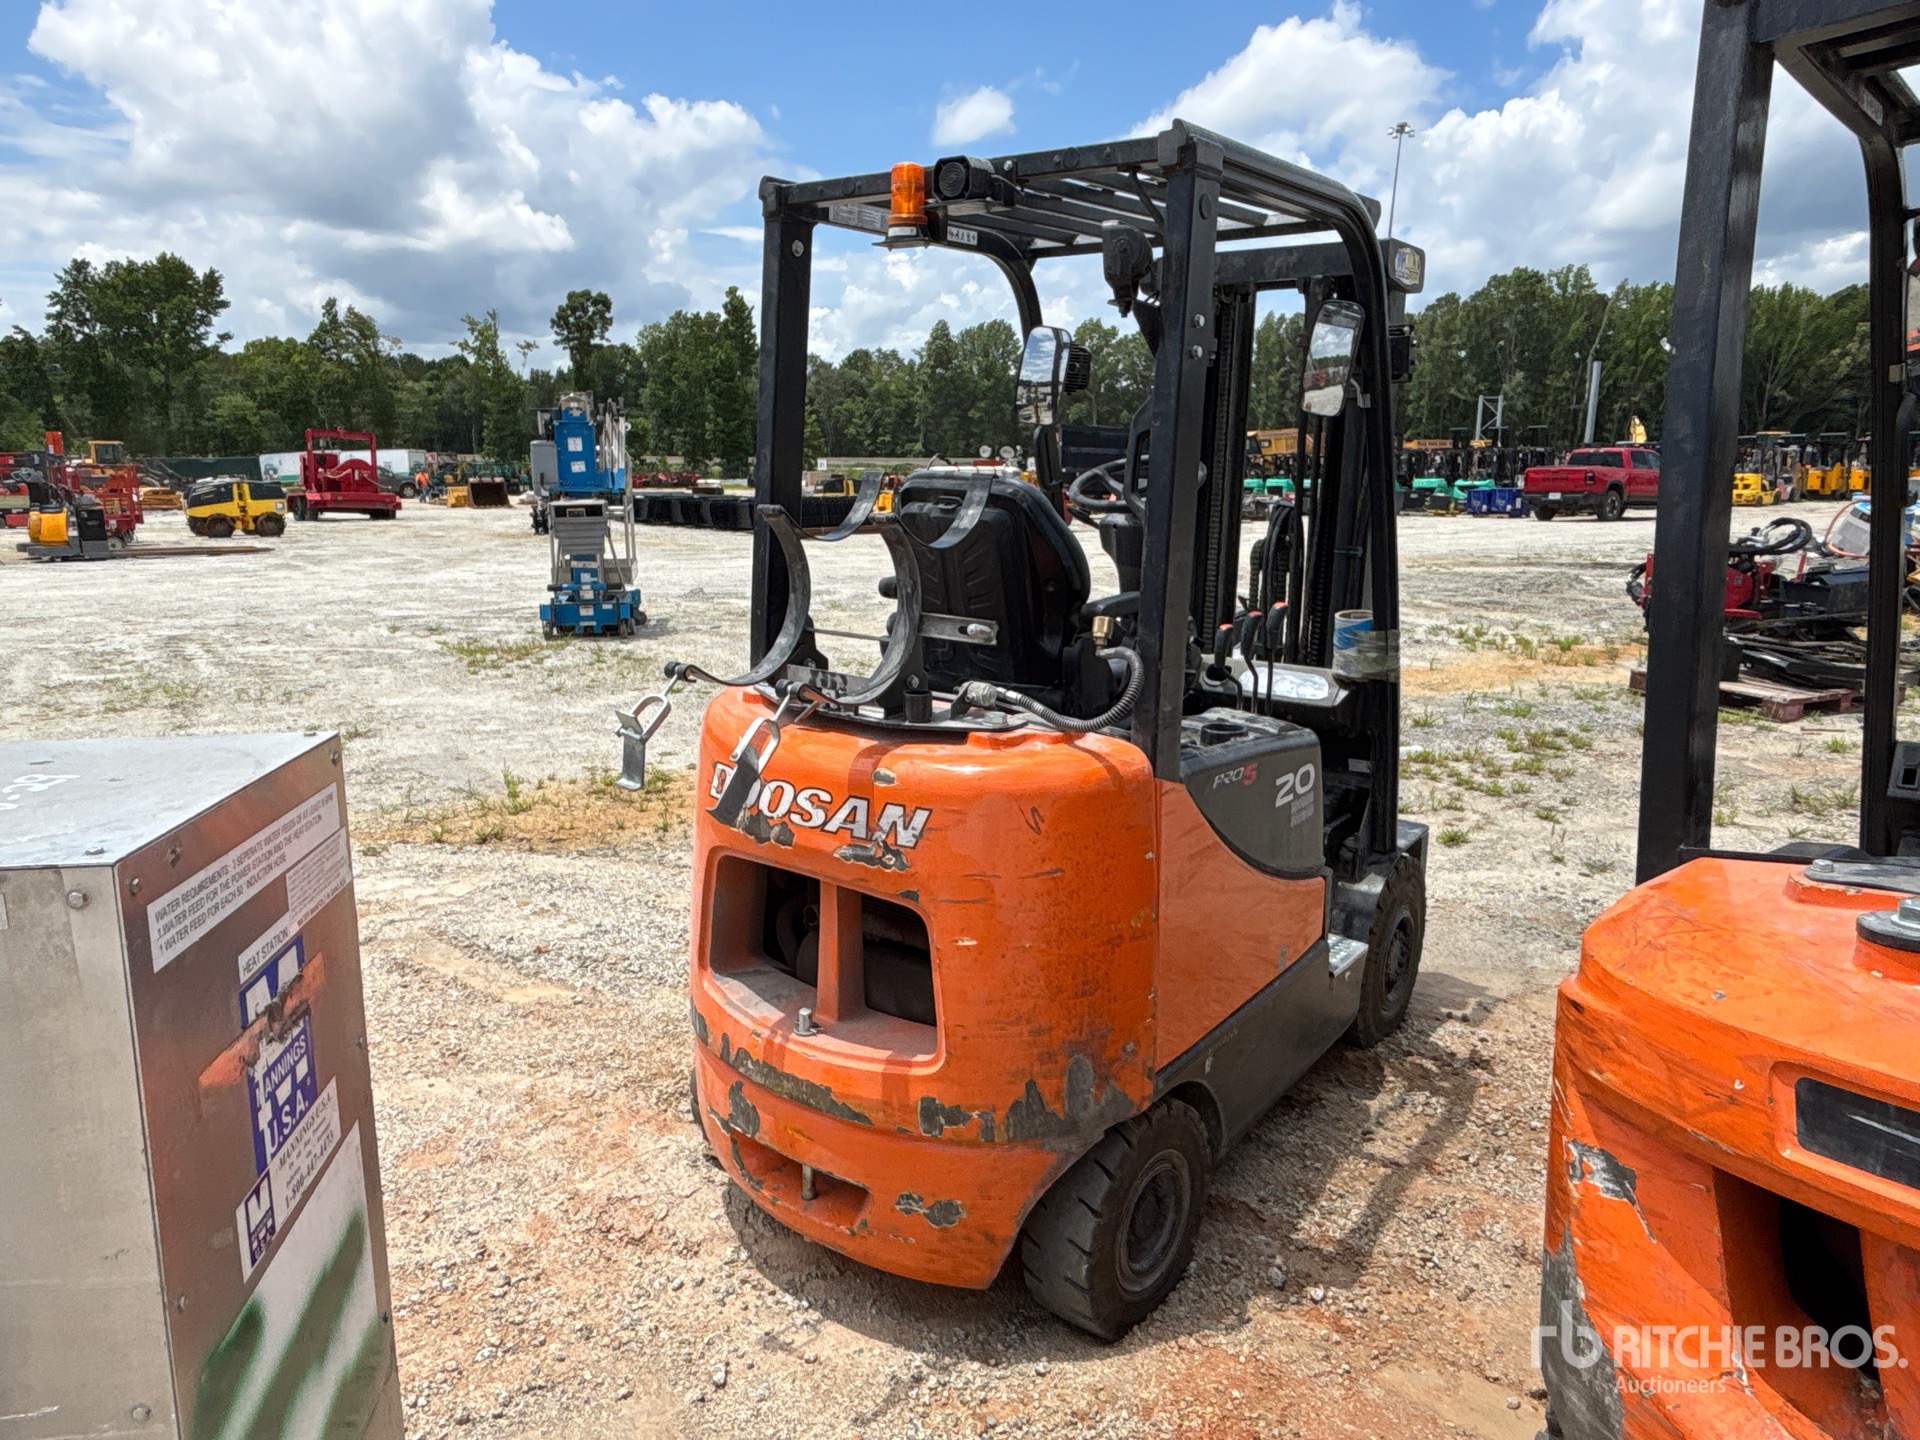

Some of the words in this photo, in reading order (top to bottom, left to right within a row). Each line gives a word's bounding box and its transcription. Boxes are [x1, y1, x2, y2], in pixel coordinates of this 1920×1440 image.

[1275, 763, 1315, 808] 20
[154, 897, 180, 923] WATER
[162, 909, 187, 935] WATER
[187, 896, 205, 917] FEED
[205, 887, 218, 903] FOR
[219, 878, 231, 893] THE
[231, 863, 251, 885] POWER
[251, 848, 273, 869] STATION
[273, 840, 283, 854] AND
[163, 925, 189, 952] WATER
[189, 911, 207, 932] FEED
[206, 902, 220, 919] FOR
[220, 890, 236, 909] EACH
[245, 862, 273, 888] INDUCTION
[242, 952, 261, 976] HEAT
[262, 927, 289, 959] STATION
